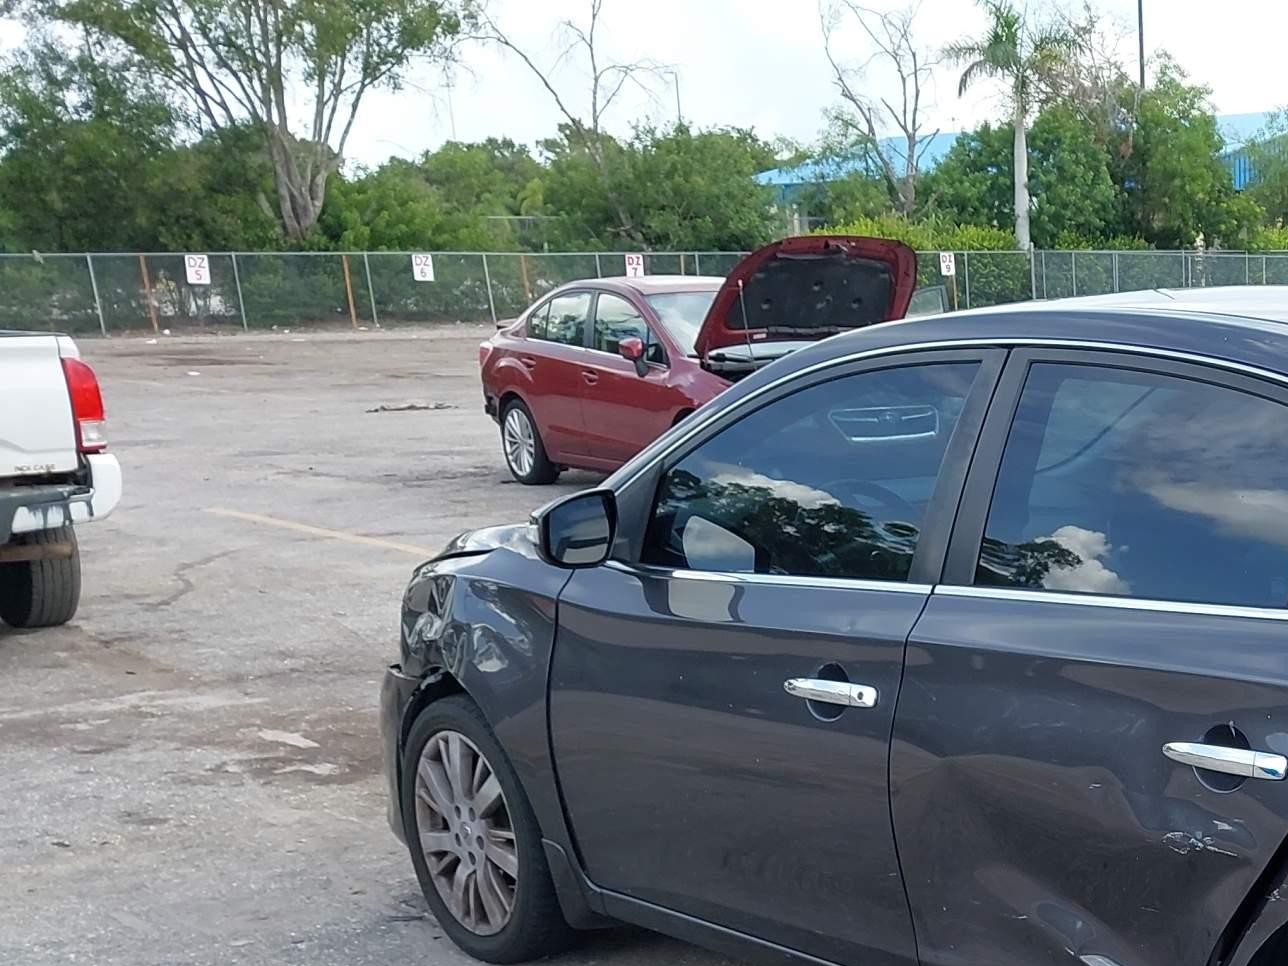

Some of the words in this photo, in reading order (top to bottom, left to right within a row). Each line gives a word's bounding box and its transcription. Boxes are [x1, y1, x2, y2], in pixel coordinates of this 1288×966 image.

[187, 256, 206, 268] DZ
[415, 255, 430, 266] DZ
[420, 267, 427, 278] 6
[632, 267, 638, 278] 7
